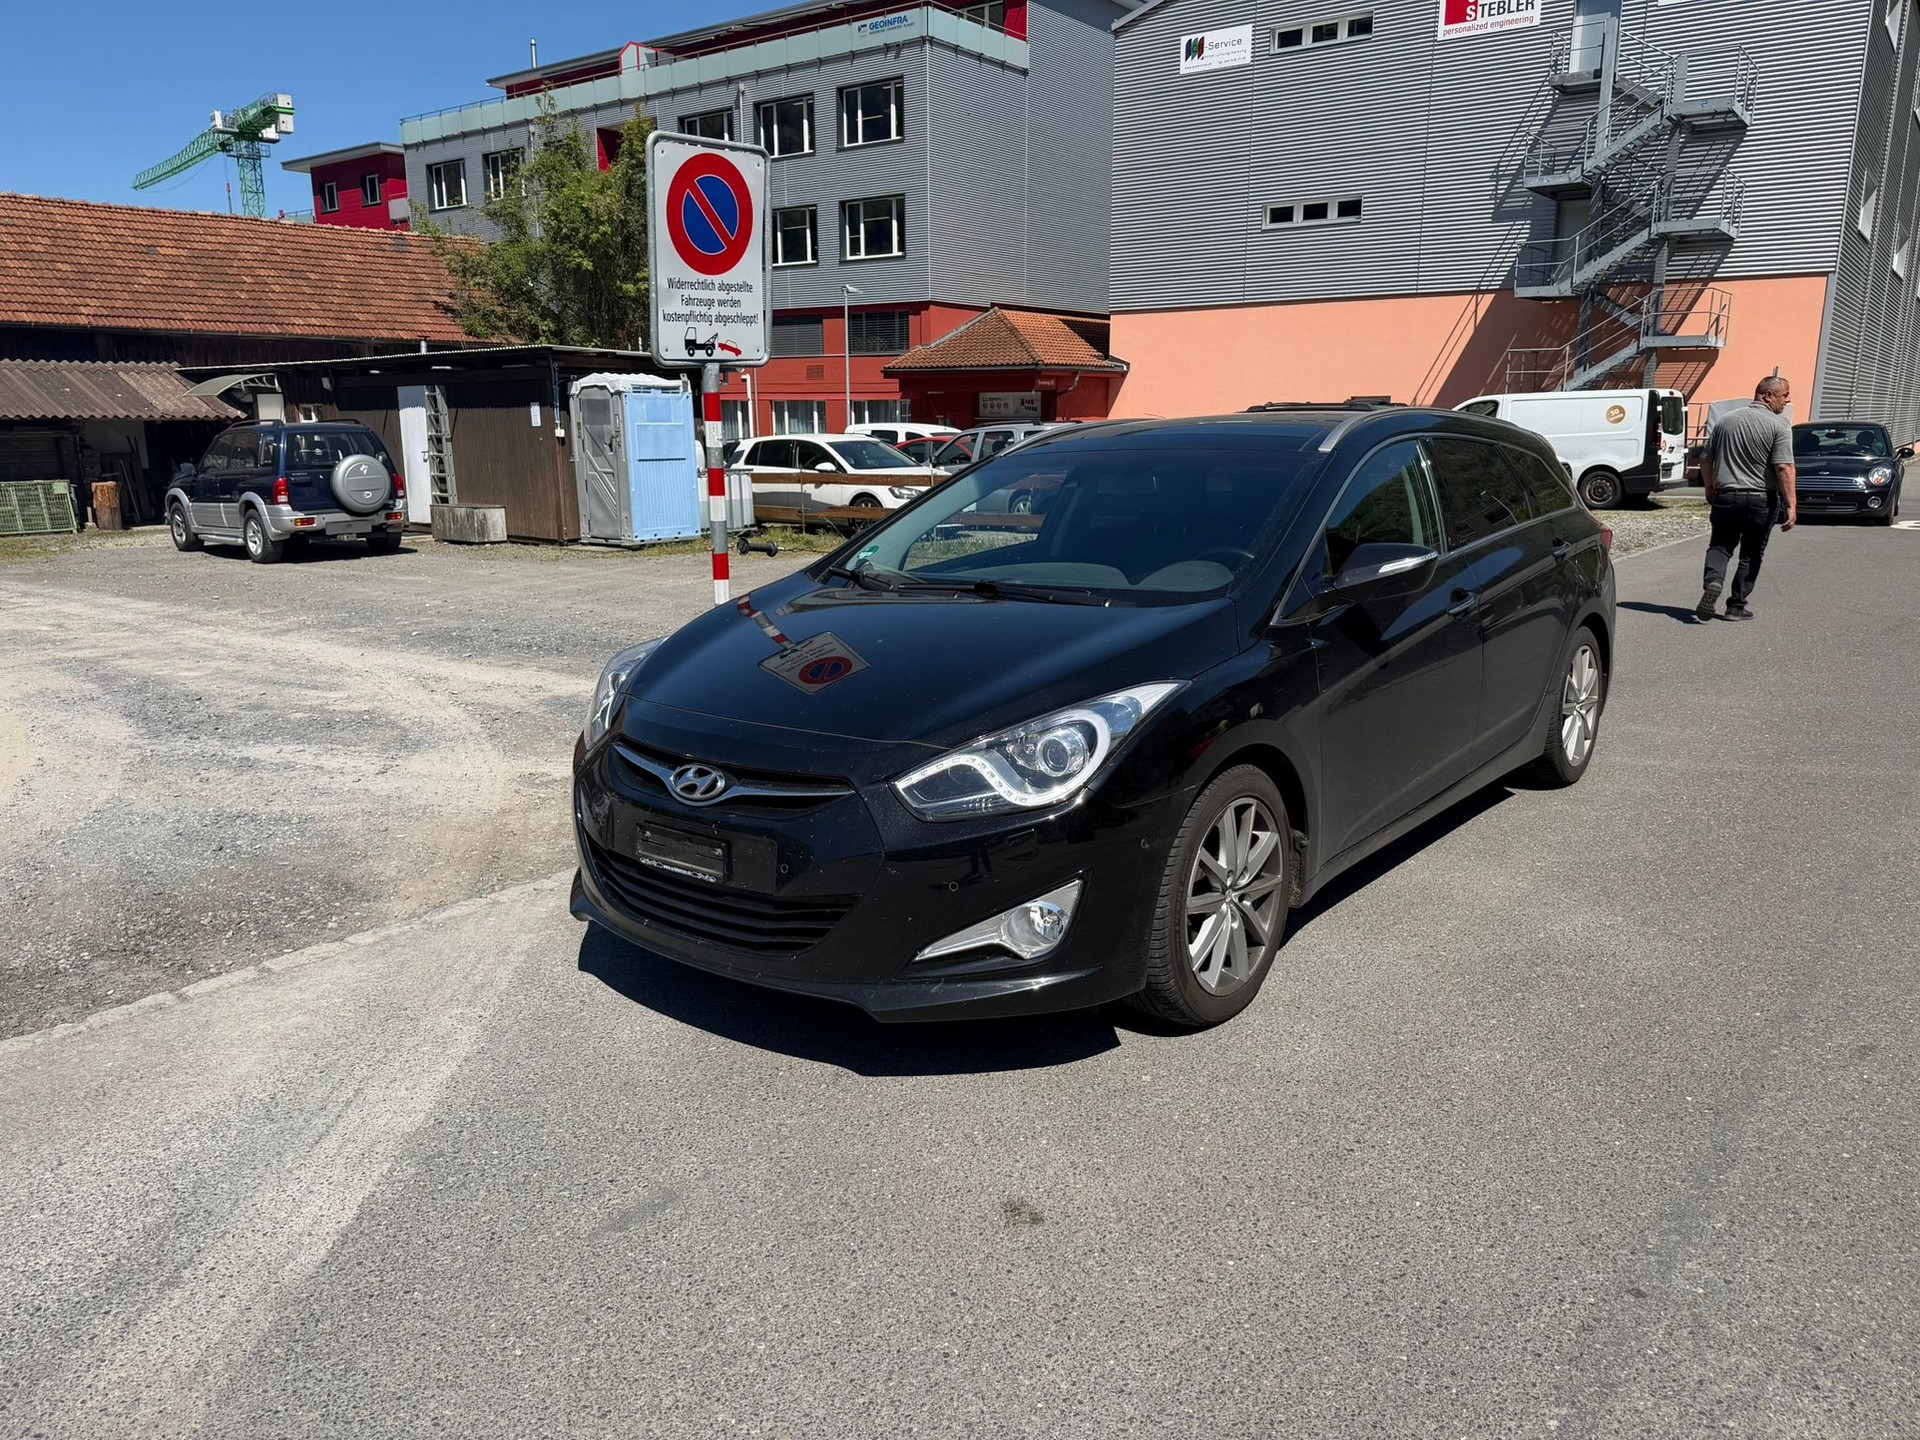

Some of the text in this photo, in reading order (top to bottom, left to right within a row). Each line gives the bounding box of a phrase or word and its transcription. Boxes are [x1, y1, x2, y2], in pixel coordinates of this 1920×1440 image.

[1466, 0, 1535, 21] STEBLER
[869, 15, 908, 30] GEOINFRA
[1443, 15, 1534, 37] personalized engineering
[667, 277, 753, 295] Widerrechtlich abgestellte
[681, 294, 742, 310] Fahrzeuge werden
[662, 309, 759, 327] kostenpflichtig abgeschleppt!
